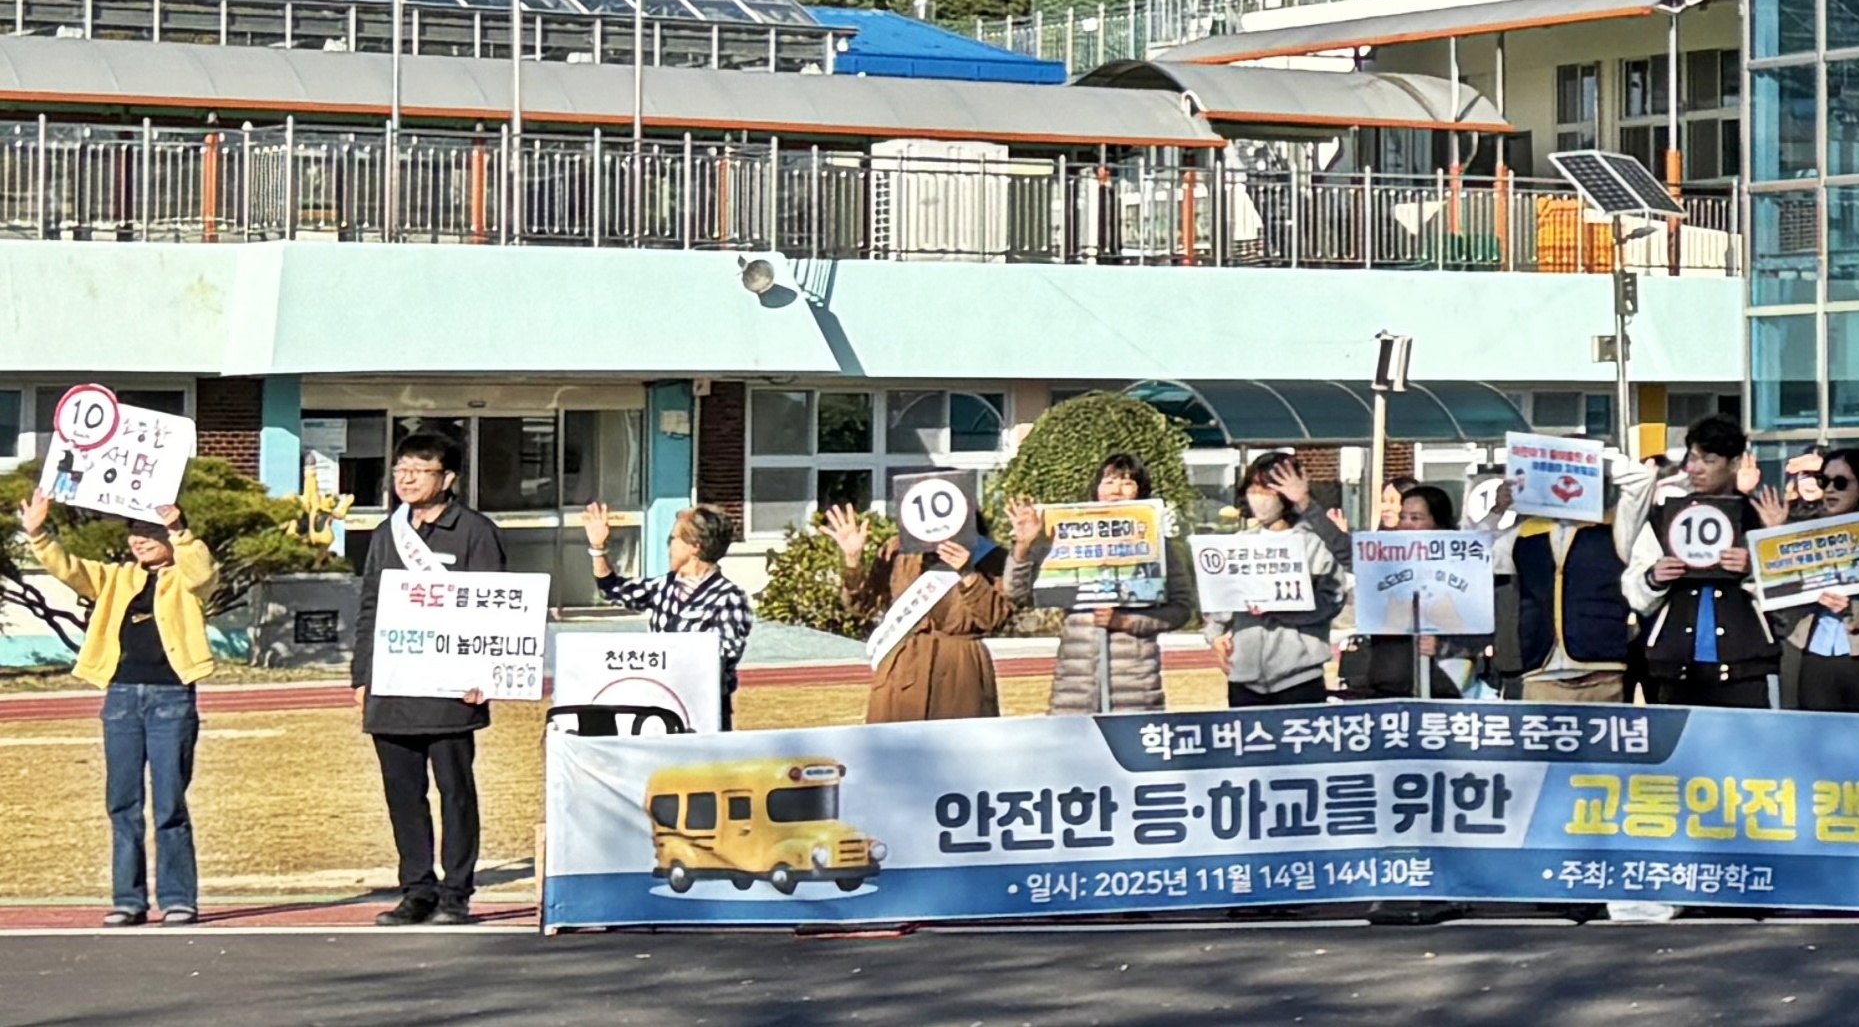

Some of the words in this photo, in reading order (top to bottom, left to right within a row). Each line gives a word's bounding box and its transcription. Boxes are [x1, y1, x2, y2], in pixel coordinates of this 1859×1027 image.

[73, 399, 104, 429] 10
[912, 490, 953, 522] 10
[1680, 516, 1722, 545] 10
[1204, 553, 1221, 569] 10
[1357, 539, 1446, 562] 10km/h의
[1450, 539, 1490, 563] 약속,
[476, 588, 528, 613] 낮추면,
[605, 650, 666, 670] 천천히
[1139, 721, 1206, 760] 학교
[1212, 719, 1277, 757] 버스
[1281, 713, 1374, 753] 주차장
[1380, 711, 1409, 749] 및
[1417, 715, 1514, 751] 통학로
[1519, 716, 1583, 752] 준공
[1589, 716, 1649, 753] 기념
[935, 785, 1119, 854] 안전한
[1132, 772, 1377, 846] 등·하교를
[1392, 770, 1512, 835] 위한
[1564, 773, 1798, 841] 교통안전
[1026, 871, 1086, 903] 일시:
[1093, 870, 1188, 898] 2025년
[1196, 864, 1252, 894] 11월
[1259, 860, 1316, 891] 14일
[1323, 859, 1377, 887] 14시
[1381, 858, 1434, 887] 30분
[1557, 860, 1614, 890] 주최:
[1621, 860, 1775, 893] 진주혜광학교
